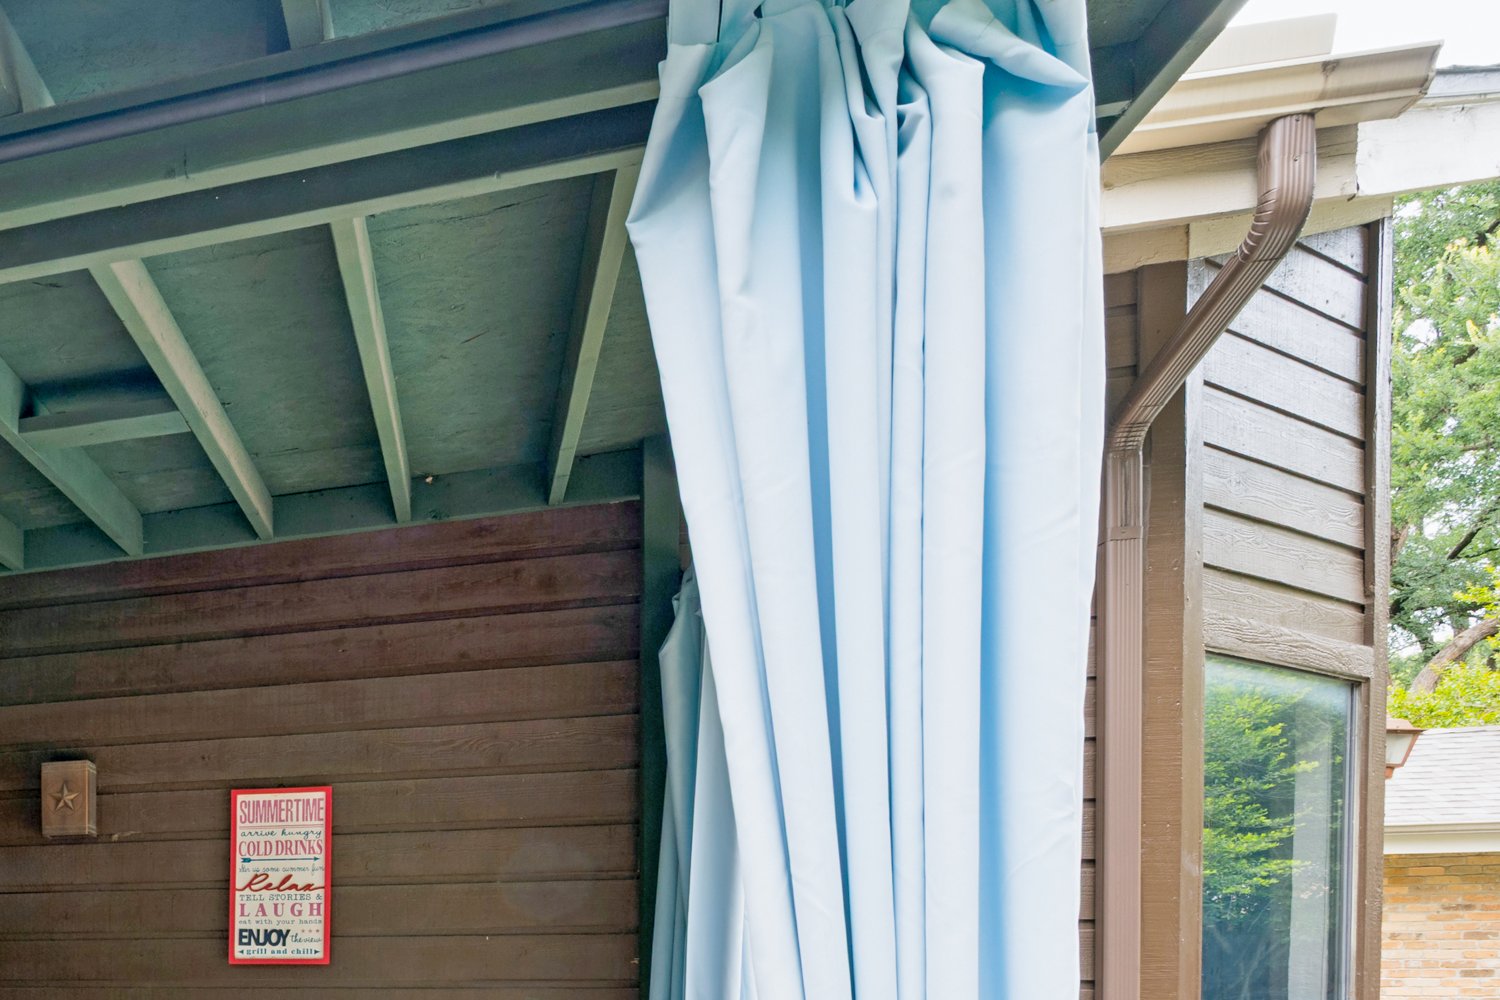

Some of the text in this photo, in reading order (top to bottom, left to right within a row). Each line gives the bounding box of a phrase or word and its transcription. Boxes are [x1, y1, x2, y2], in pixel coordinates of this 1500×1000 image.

[240, 798, 324, 824] SUMMERTIME
[281, 828, 322, 840] hungry
[238, 839, 323, 857] COLD DRINKS
[235, 873, 325, 892] Relax
[269, 893, 311, 901] STORIES
[239, 902, 322, 917] LAUGH
[238, 928, 291, 946] ENJOY
[290, 932, 303, 943] the
